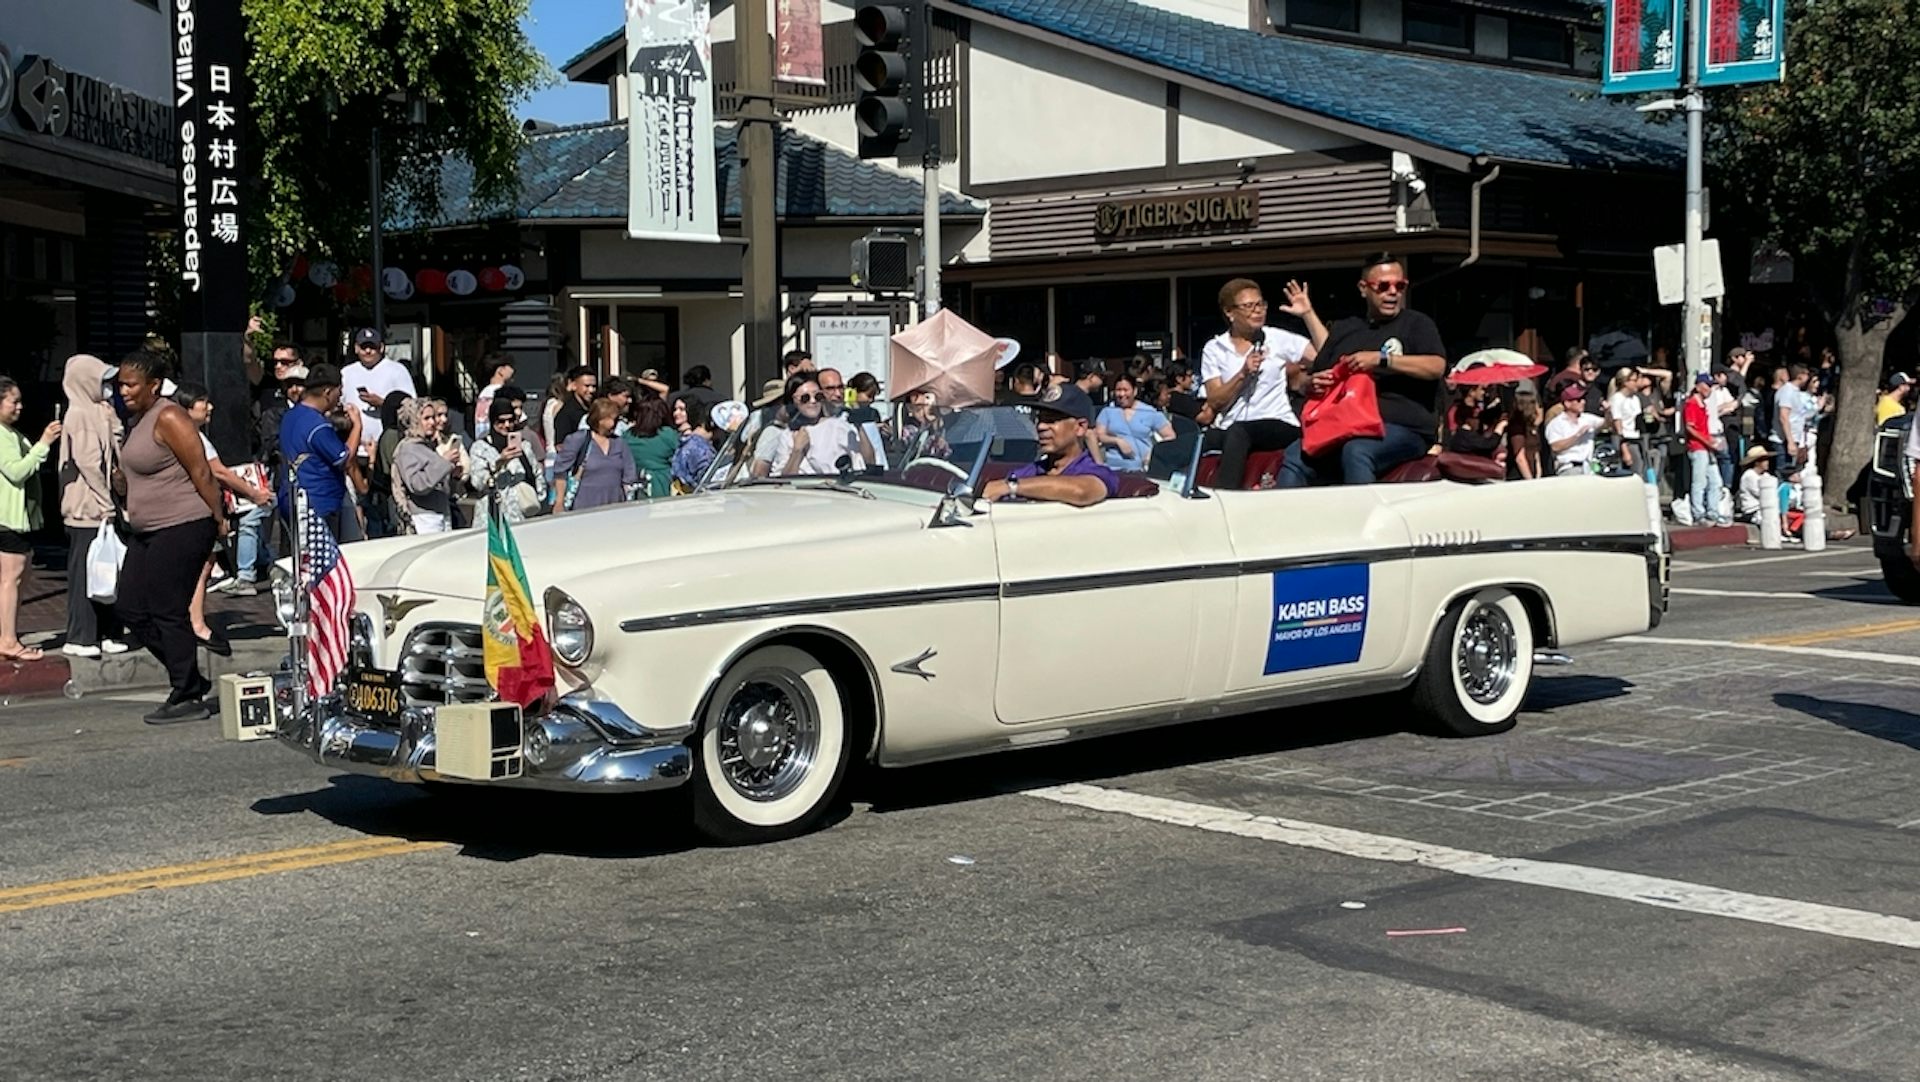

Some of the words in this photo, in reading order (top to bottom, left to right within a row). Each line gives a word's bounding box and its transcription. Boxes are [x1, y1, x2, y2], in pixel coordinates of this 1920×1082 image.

[72, 73, 125, 128] KURA
[126, 91, 175, 143] SUSHI
[207, 65, 240, 244] 日本村広場
[181, 120, 201, 292] Japanese
[1122, 202, 1178, 228] TIGER
[1184, 196, 1250, 223] SUGAR
[819, 319, 881, 330] 日本村プラザ
[1278, 600, 1325, 620] KAREN
[1329, 595, 1364, 614] BASS
[1275, 630, 1302, 641] MAYOR
[1303, 628, 1313, 639] OF
[1314, 626, 1329, 637] LOS
[1330, 621, 1361, 634] ANGELES
